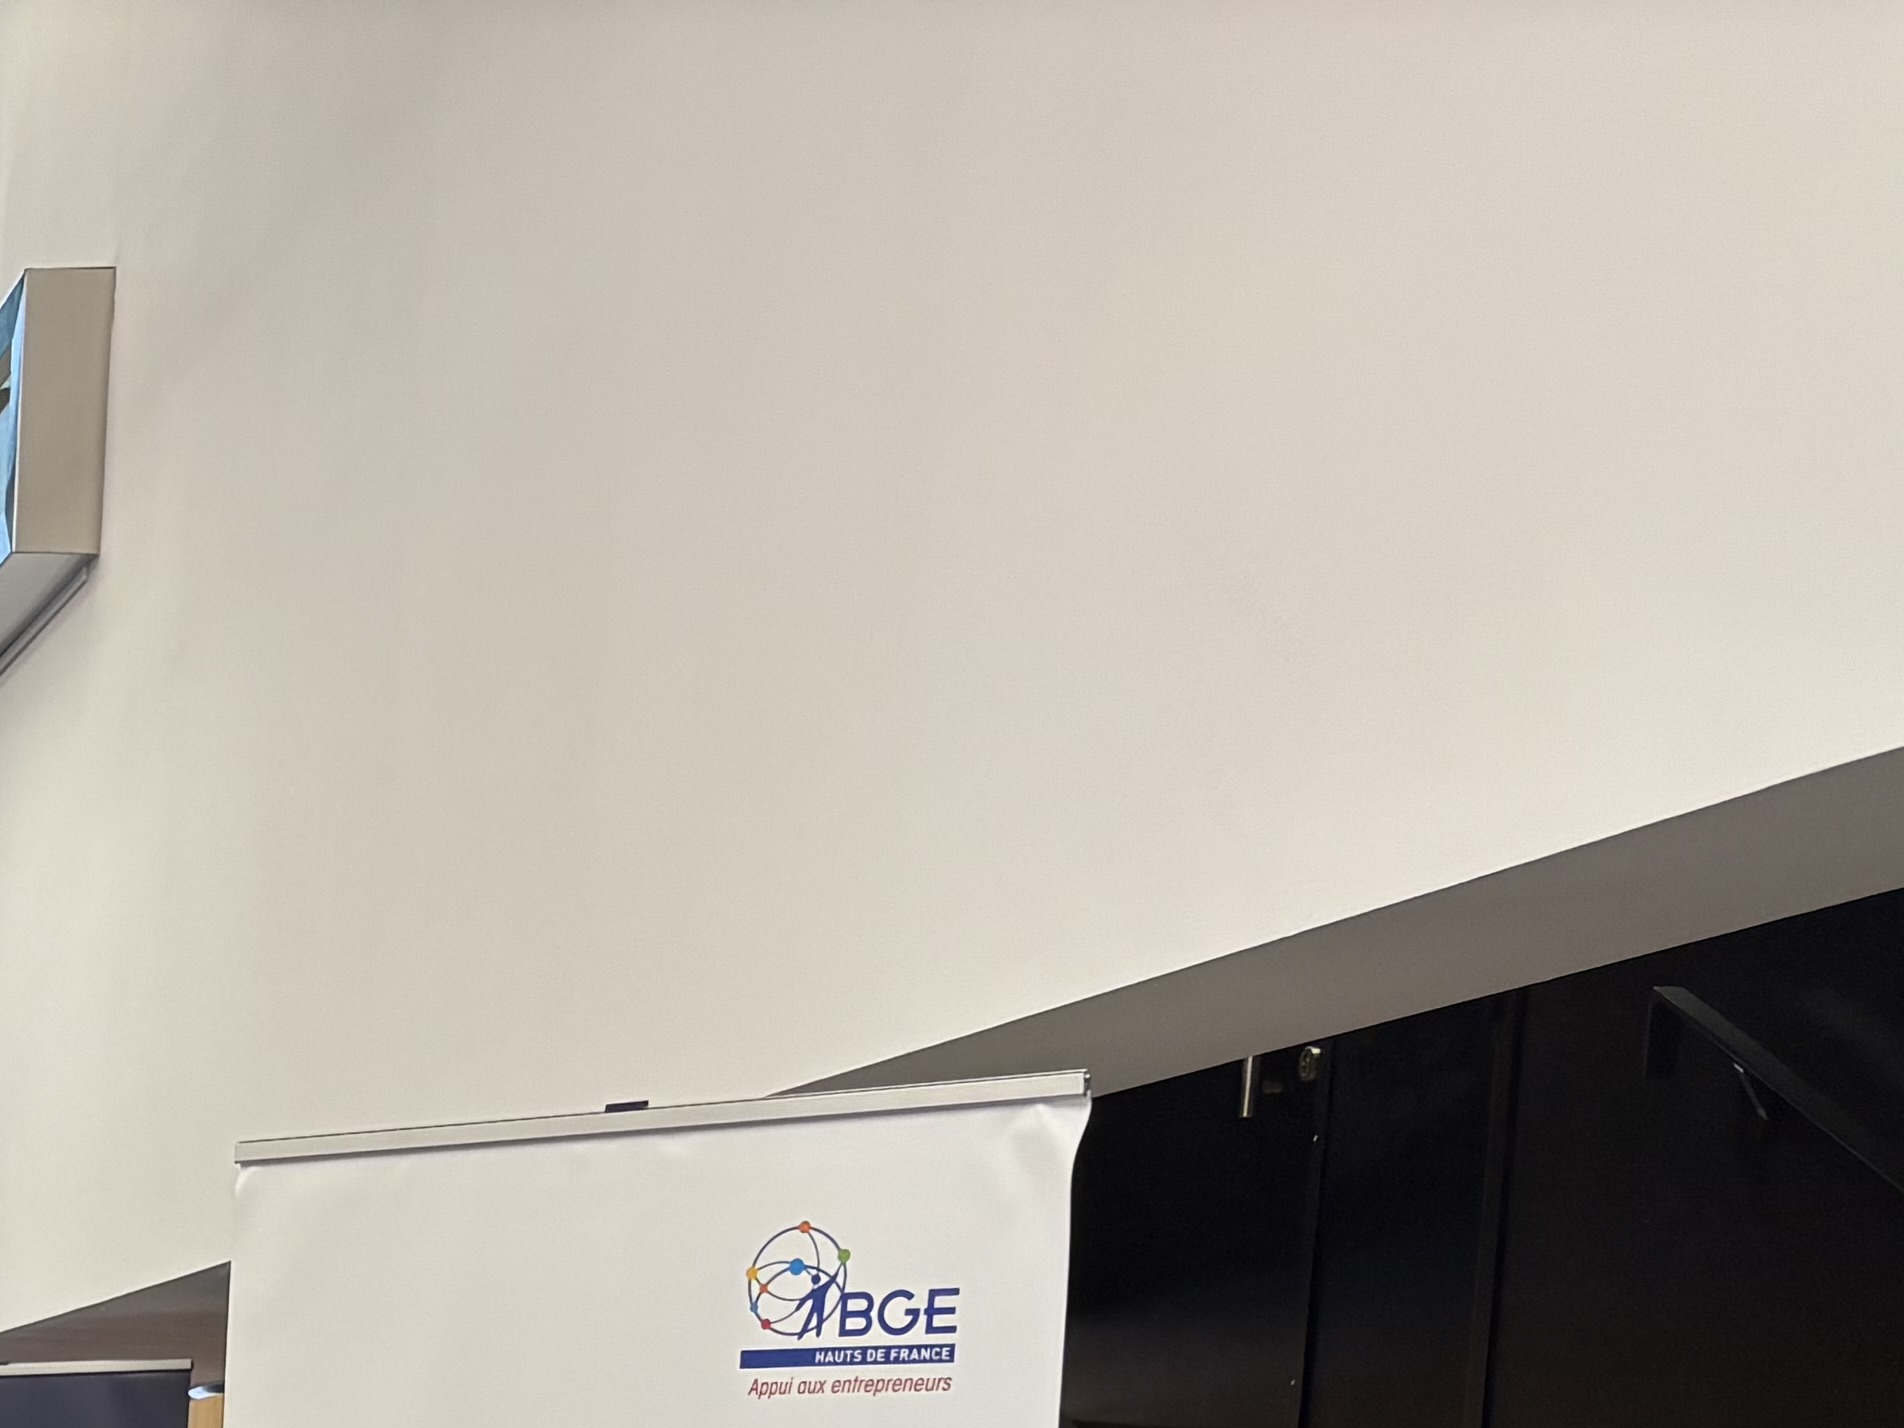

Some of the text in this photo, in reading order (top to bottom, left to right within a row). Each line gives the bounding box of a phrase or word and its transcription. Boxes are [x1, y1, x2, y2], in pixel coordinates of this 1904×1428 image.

[839, 1288, 960, 1337] BGE
[815, 1347, 951, 1364] HAUTS DE FRANCE
[748, 1376, 952, 1399] Appui aux entrepreneurs
